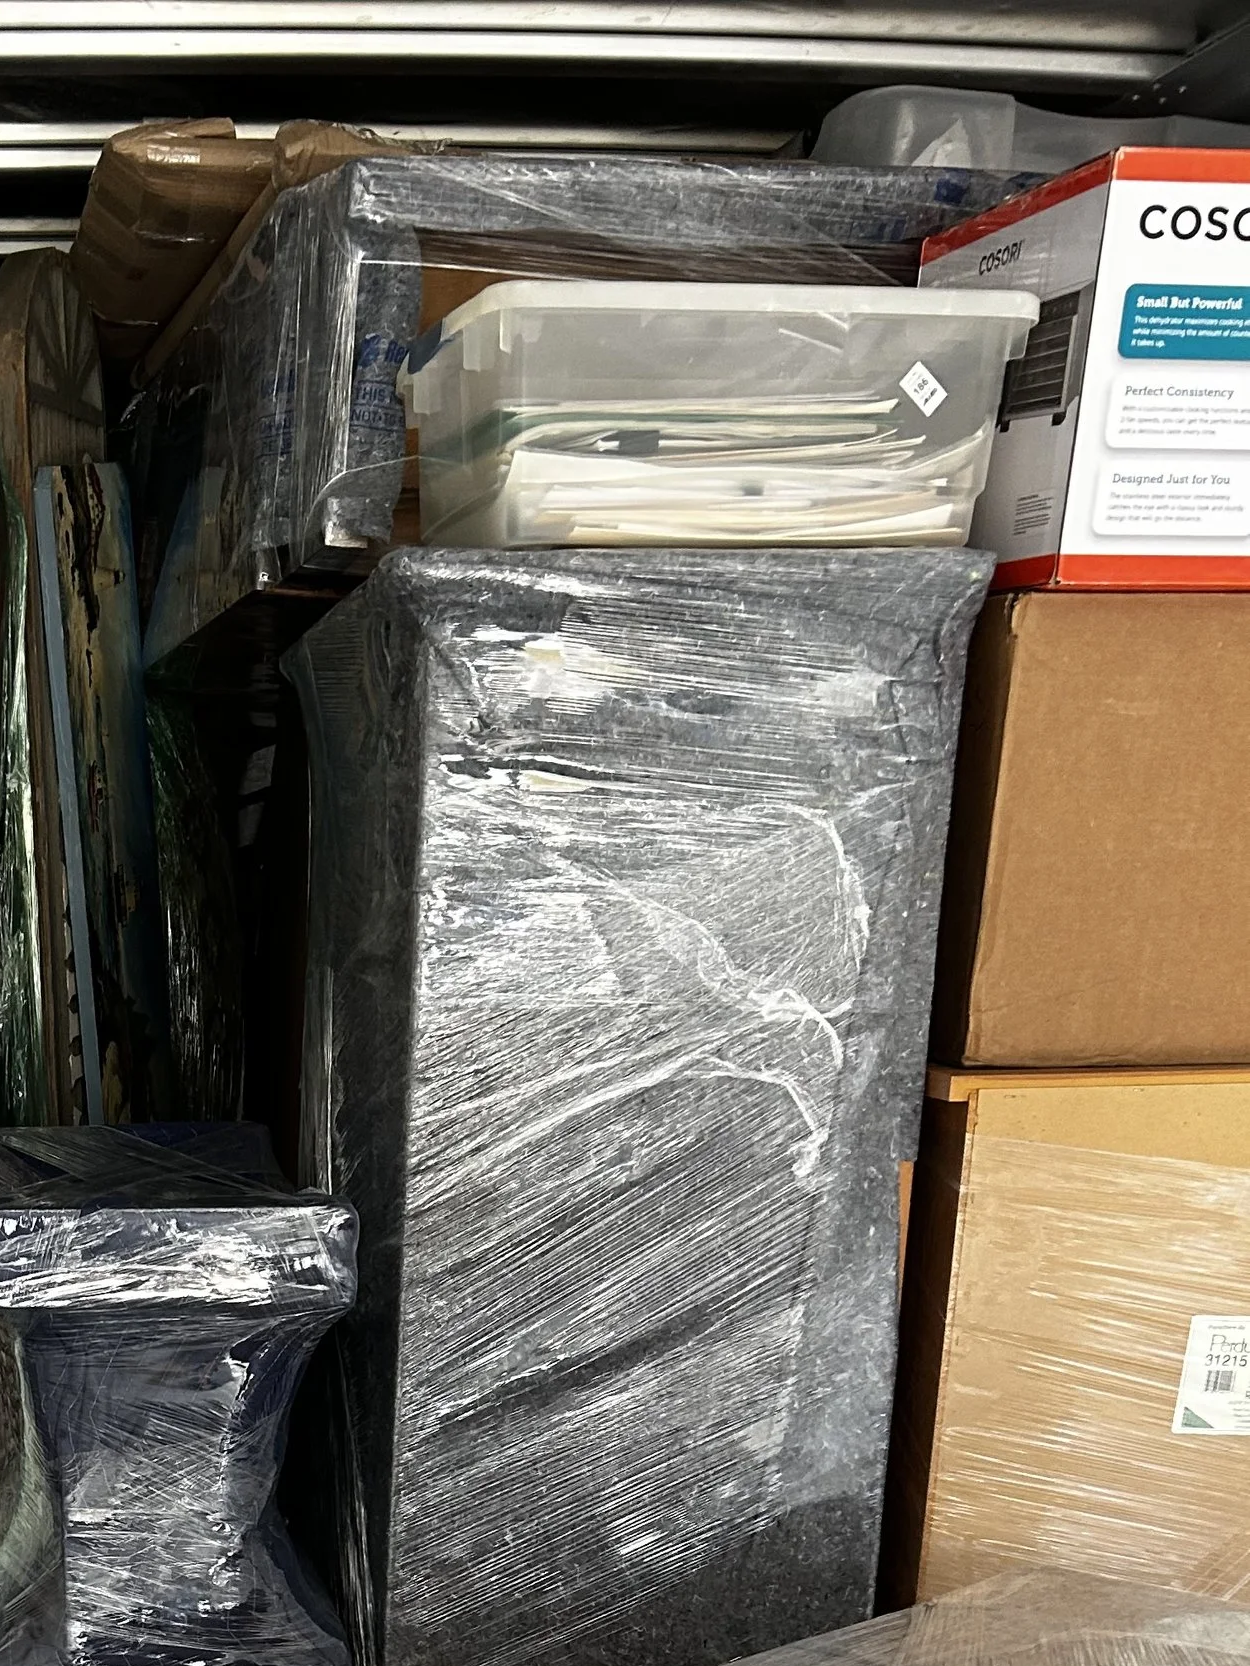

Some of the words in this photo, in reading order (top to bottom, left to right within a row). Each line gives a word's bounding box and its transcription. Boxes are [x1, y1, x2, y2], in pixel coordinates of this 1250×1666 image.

[978, 241, 1020, 275] COSORI
[1136, 295, 1168, 308] Small
[1170, 296, 1191, 309] But
[1192, 296, 1243, 310] Powerful
[1125, 386, 1163, 397] Perfect
[1167, 387, 1234, 400] Consistency
[1112, 473, 1164, 486] Designed
[1166, 474, 1189, 484] Just
[1192, 475, 1208, 485] for
[1211, 475, 1231, 485] You
